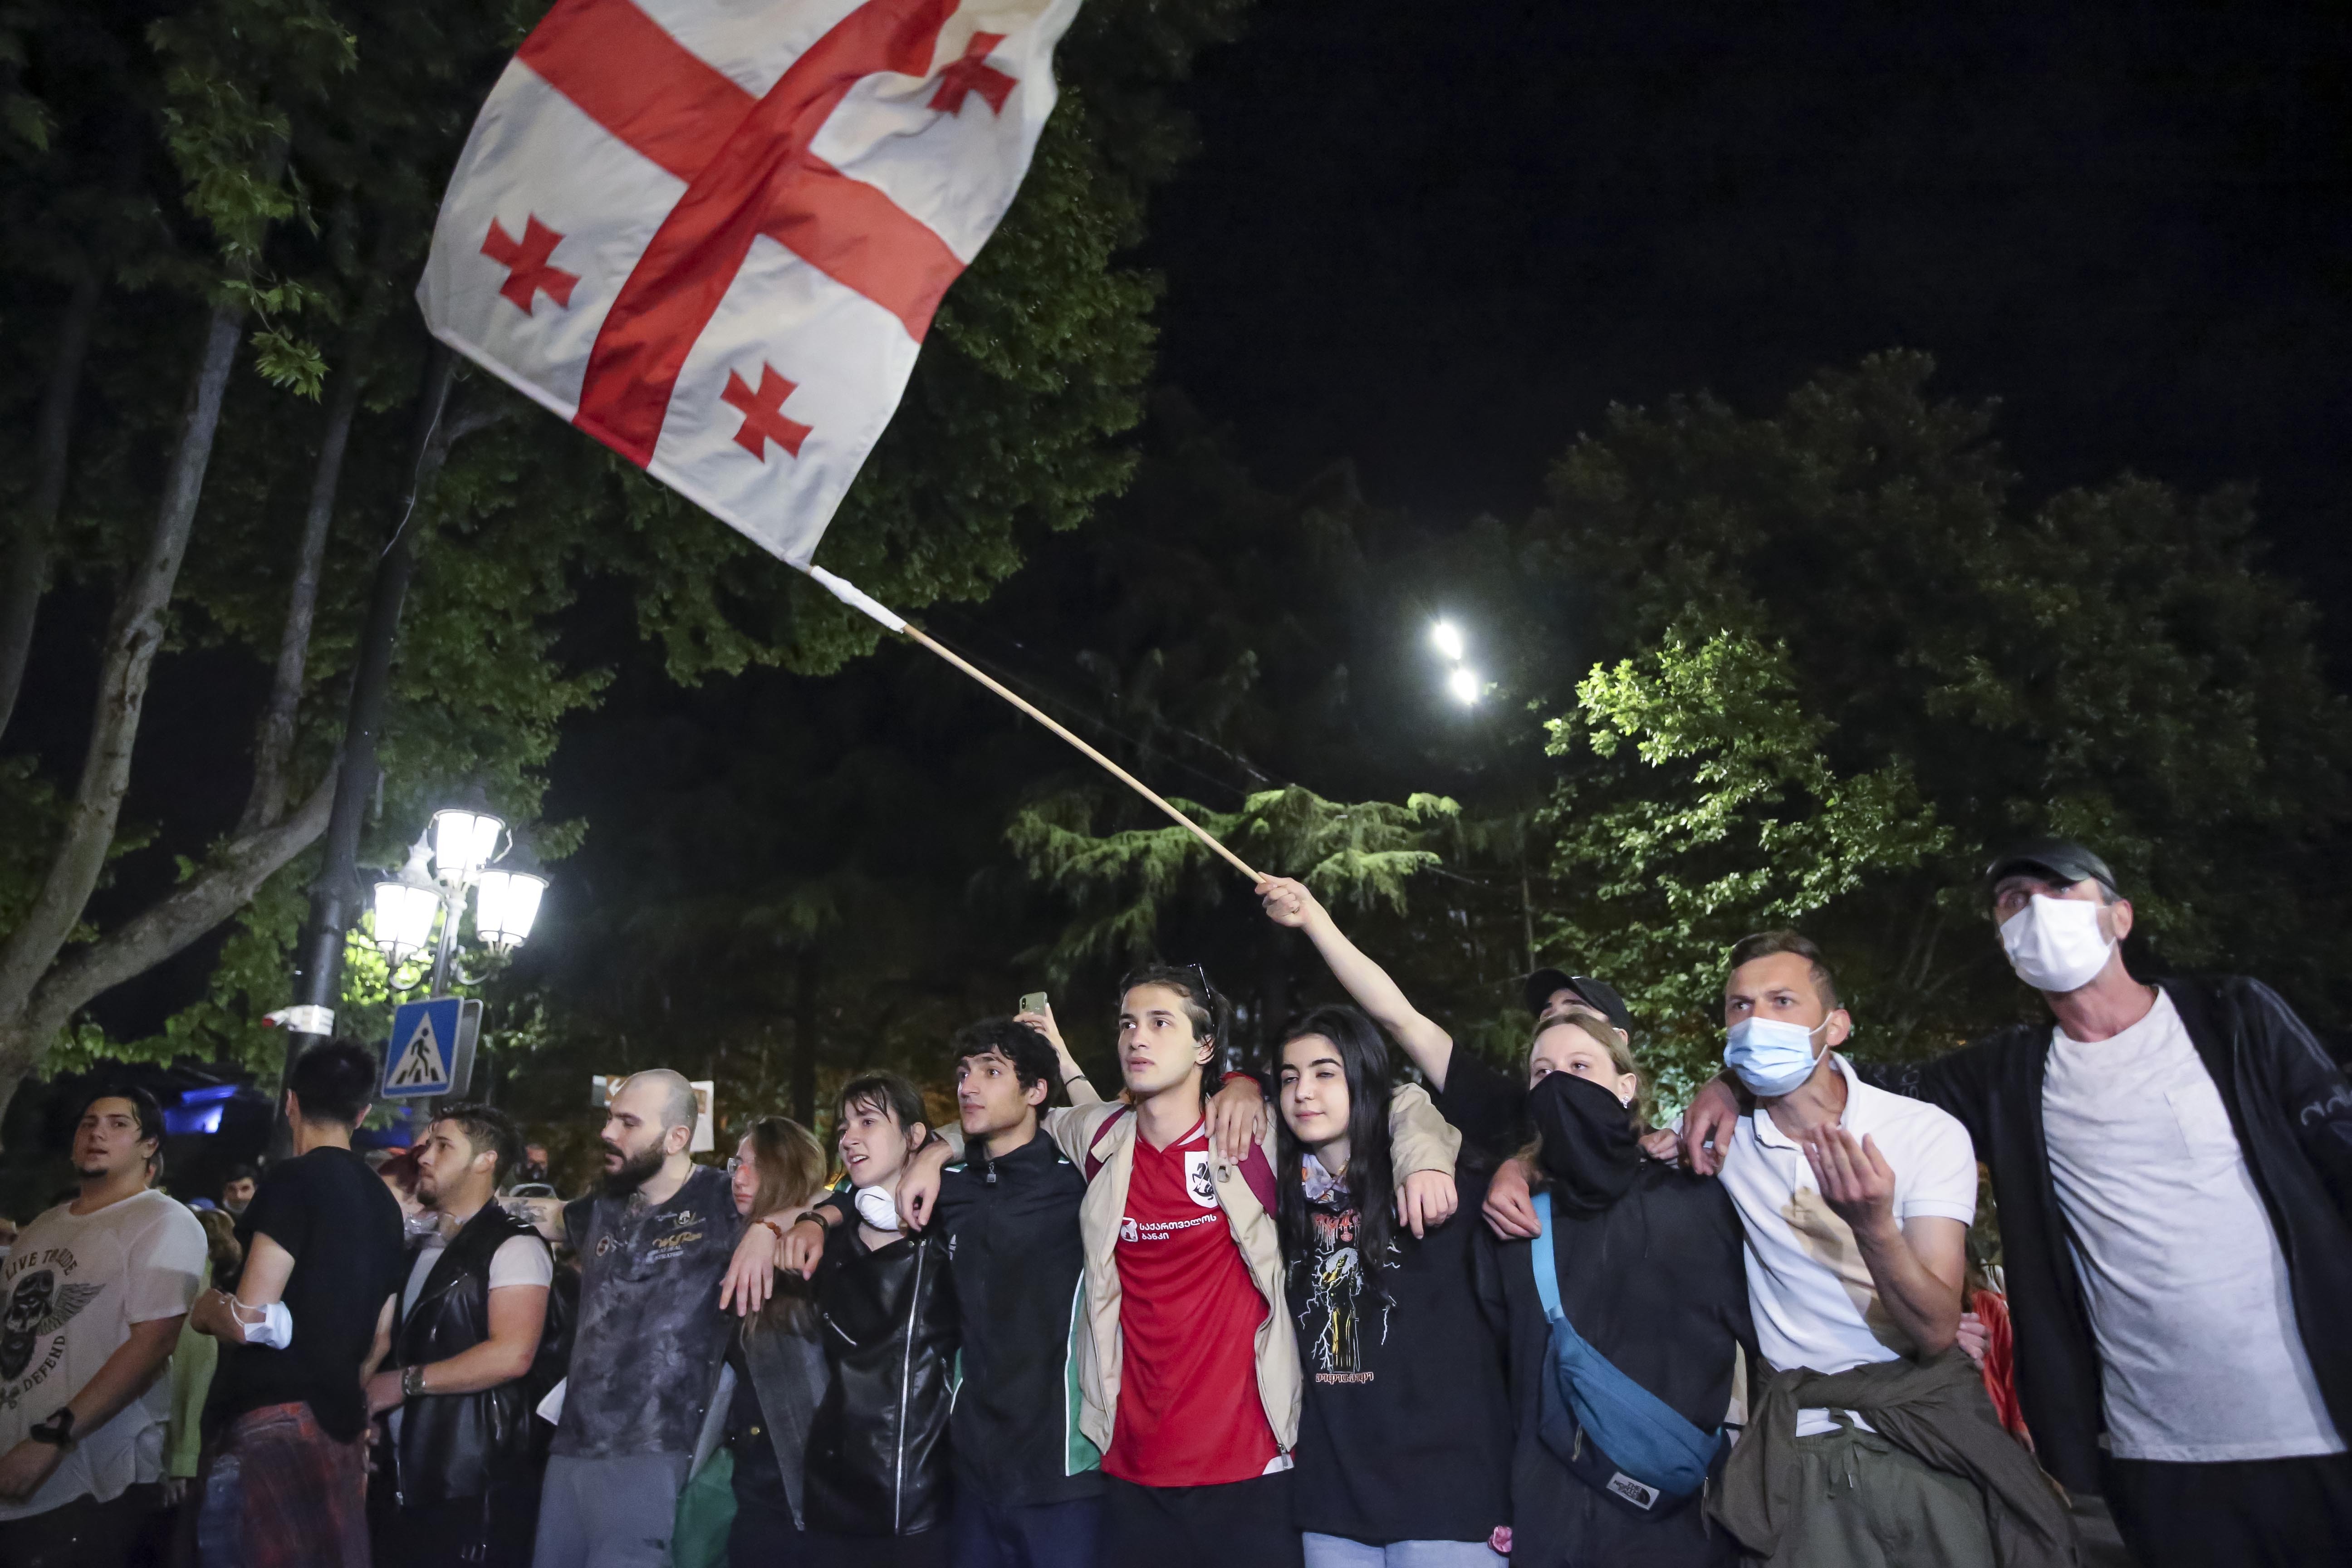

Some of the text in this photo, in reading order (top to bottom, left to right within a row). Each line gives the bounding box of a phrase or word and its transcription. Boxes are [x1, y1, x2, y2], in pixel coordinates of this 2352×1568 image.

[1139, 1214, 1217, 1230] საქართველოს
[5, 1251, 38, 1281] LIVE
[23, 1335, 66, 1392] DEFEND
